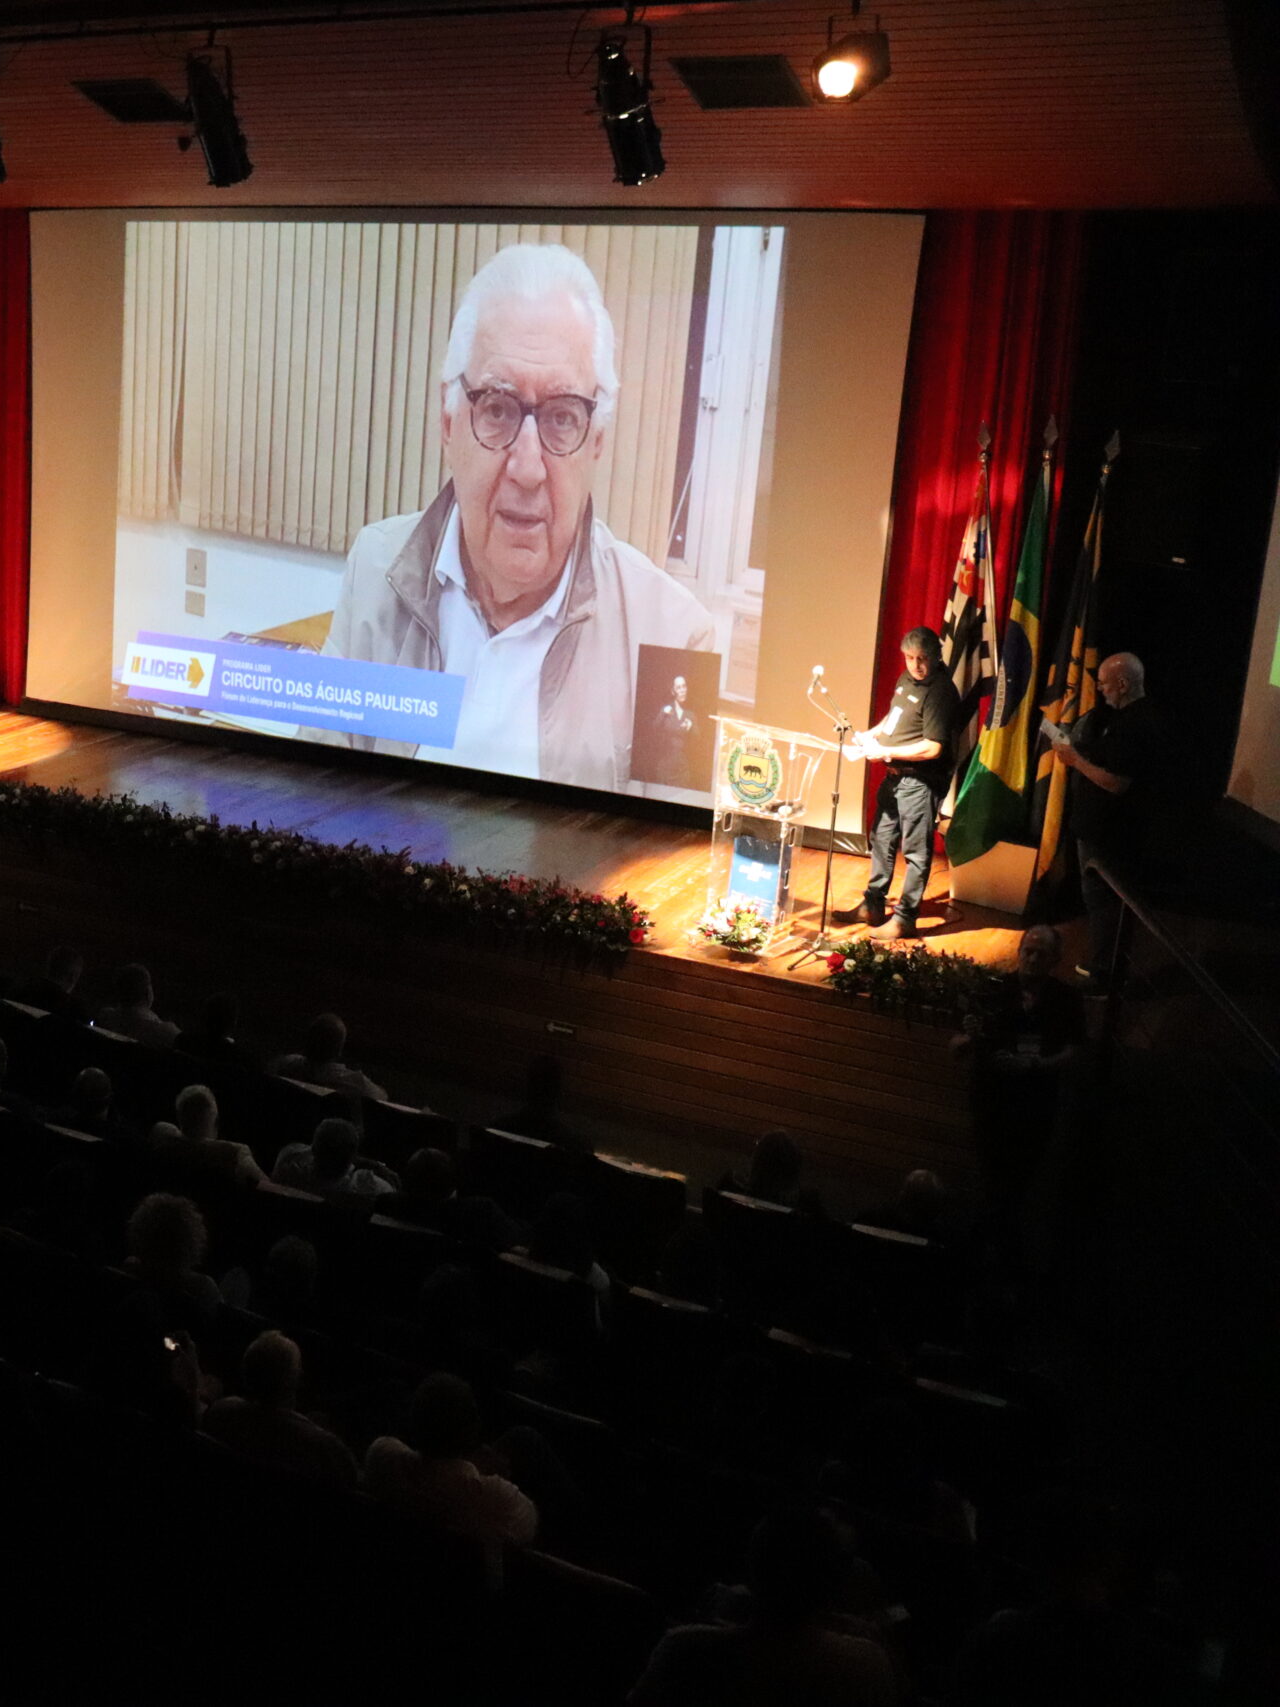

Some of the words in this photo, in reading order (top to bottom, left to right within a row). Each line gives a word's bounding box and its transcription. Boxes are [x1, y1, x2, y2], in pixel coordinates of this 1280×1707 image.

[141, 657, 186, 681] LIDER
[221, 671, 283, 694] CIRCUITO
[285, 680, 313, 698] DAS
[315, 680, 362, 706] ÁGUAS
[364, 691, 438, 718] PAULISTAS
